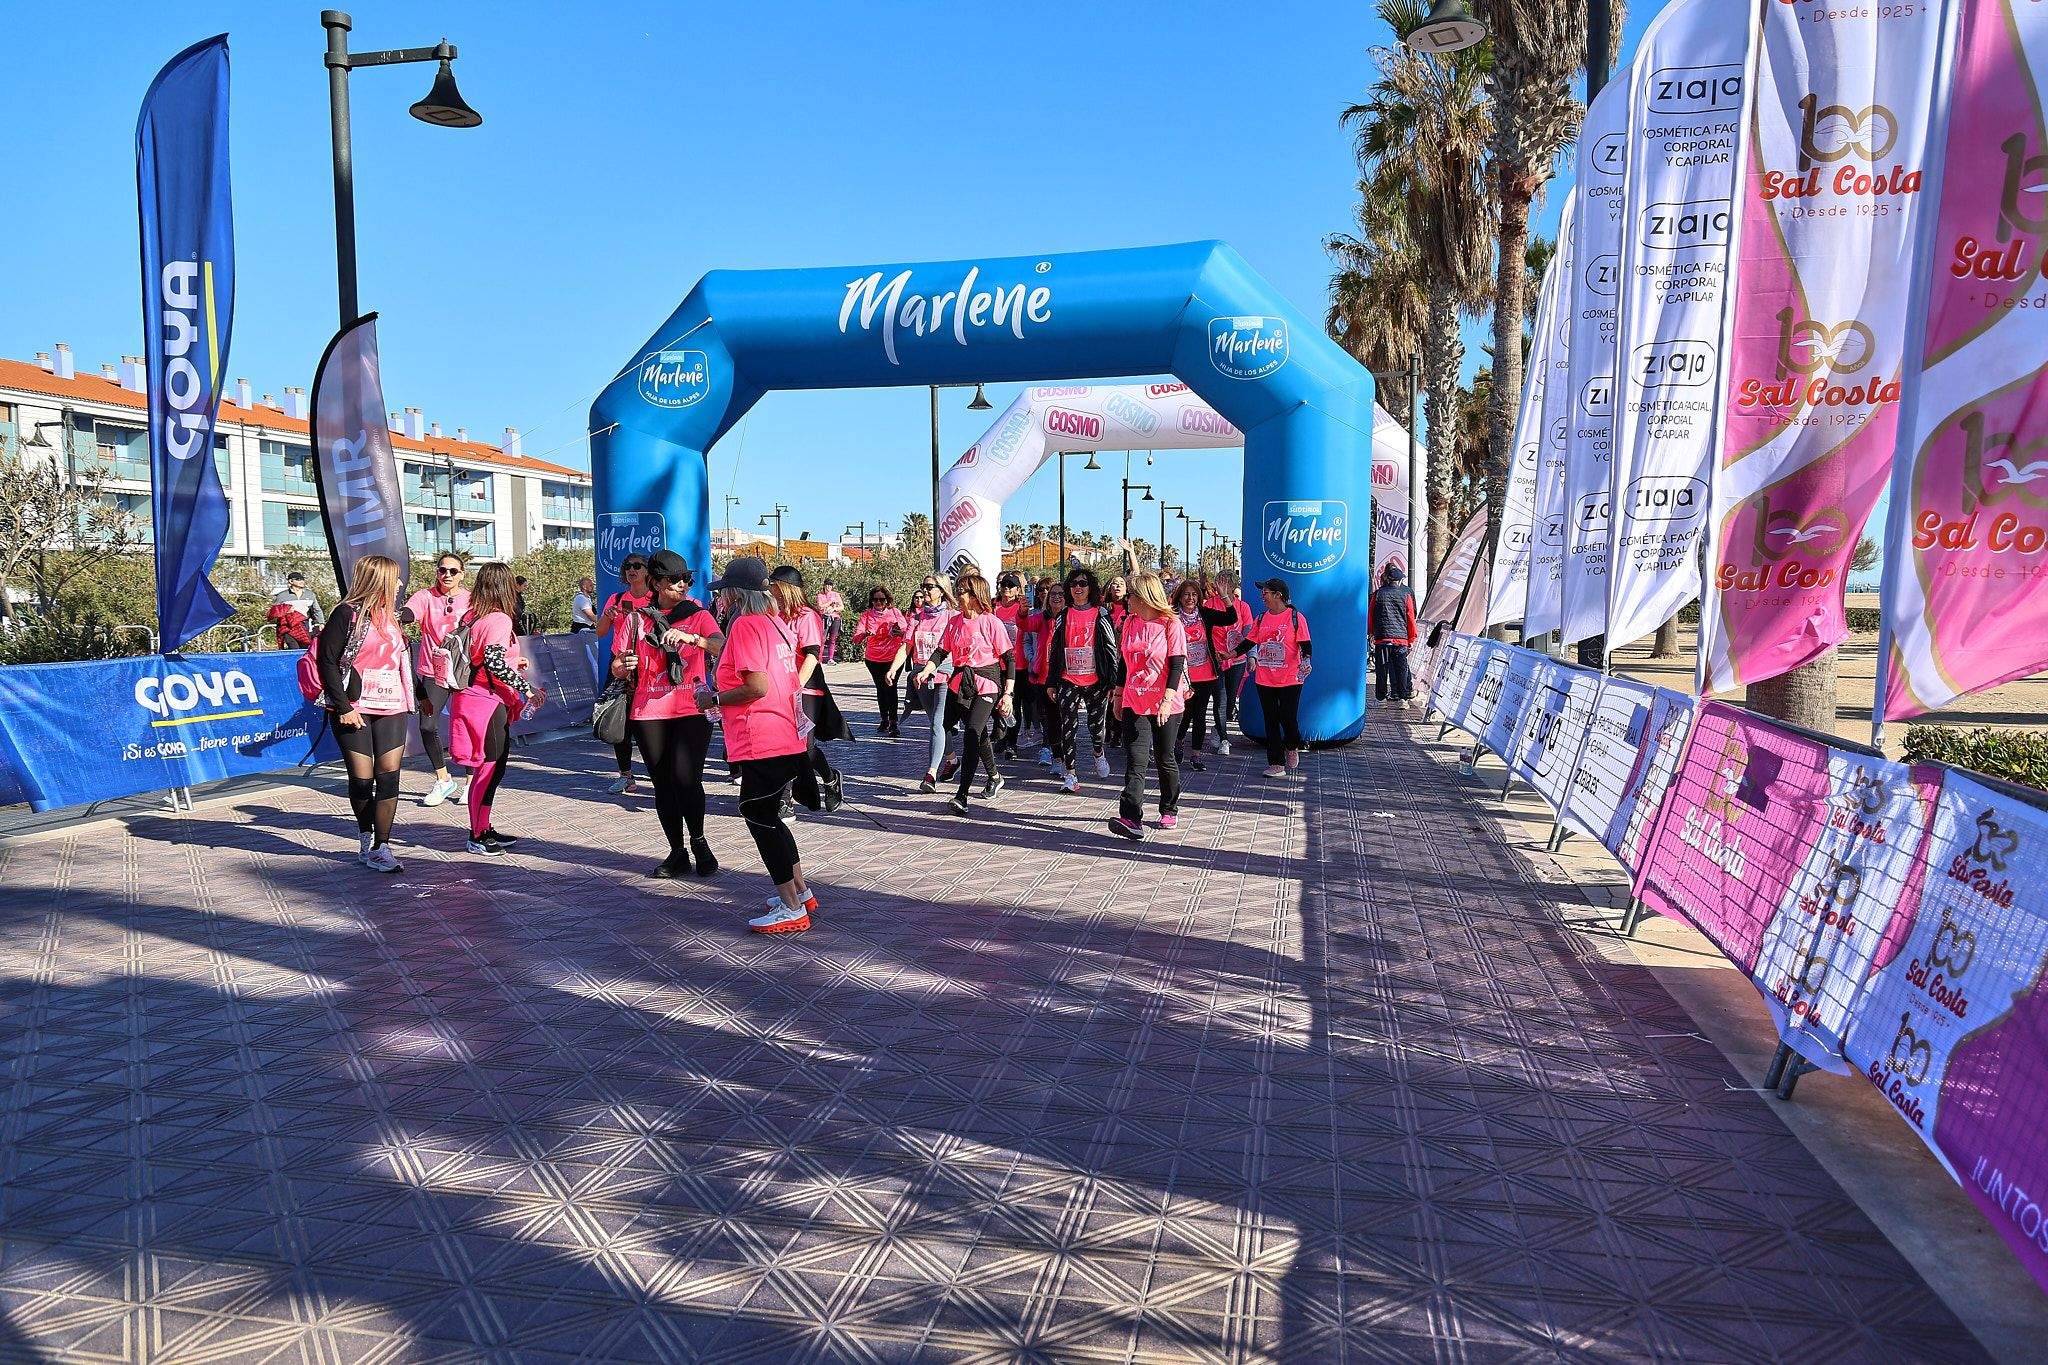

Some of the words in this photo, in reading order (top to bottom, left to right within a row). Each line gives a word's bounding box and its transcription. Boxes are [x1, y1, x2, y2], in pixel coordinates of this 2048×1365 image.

[1814, 6, 1868, 22] Desde
[1876, 5, 1914, 18] 1925
[1656, 77, 1742, 105] ziaja
[1663, 138, 1733, 152] CORPORAL
[1665, 157, 1674, 166] Y
[1675, 153, 1729, 167] CAPILAR
[1759, 167, 1823, 200] Sal
[1833, 165, 1923, 196] Costa
[1792, 205, 1847, 219] Desde
[1856, 204, 1889, 216] 1925
[1951, 236, 2027, 282] Sal
[1655, 277, 1717, 290] CORPORAL
[1656, 295, 1664, 304] Y
[1666, 292, 1714, 304] CAPILAR
[839, 266, 1051, 366] Marlene
[162, 260, 209, 460] GOYA
[1215, 329, 1284, 363] Marlene
[643, 363, 704, 392] Marlene
[1219, 362, 1233, 374] HIJA
[1258, 360, 1278, 374] ALPES
[1642, 353, 1706, 380] ziaja
[659, 396, 668, 404] DE
[669, 397, 681, 405] LOS
[682, 391, 700, 404] ALPES
[1738, 377, 1798, 408] Sal
[1806, 376, 1902, 407] Costa
[1049, 410, 1100, 438] COSMO
[1106, 393, 1156, 433] COSMO
[1769, 415, 1819, 426] Desde
[1829, 413, 1867, 426] 1925
[332, 429, 387, 546] IMR
[600, 527, 661, 560] Marlene
[1267, 516, 1342, 554] Marlene
[1912, 510, 1980, 552] Sal
[1987, 511, 2048, 555] Co
[1270, 552, 1284, 565] HIJA
[1286, 560, 1296, 568] DE
[1314, 553, 1336, 568] ALPES
[1945, 561, 2005, 579] Desde
[1714, 563, 1773, 592] Sal
[135, 670, 259, 717] GOYA
[144, 746, 157, 758] es
[157, 741, 187, 758] GOYA
[231, 734, 251, 753] que
[254, 731, 272, 743] ser
[274, 722, 308, 740] bueno!
[1679, 805, 1711, 849] Sal
[1905, 957, 1932, 991] Sal
[1928, 973, 1969, 1020] Costa
[1867, 1059, 1891, 1095] Sal
[1889, 1079, 1926, 1131] Costa
